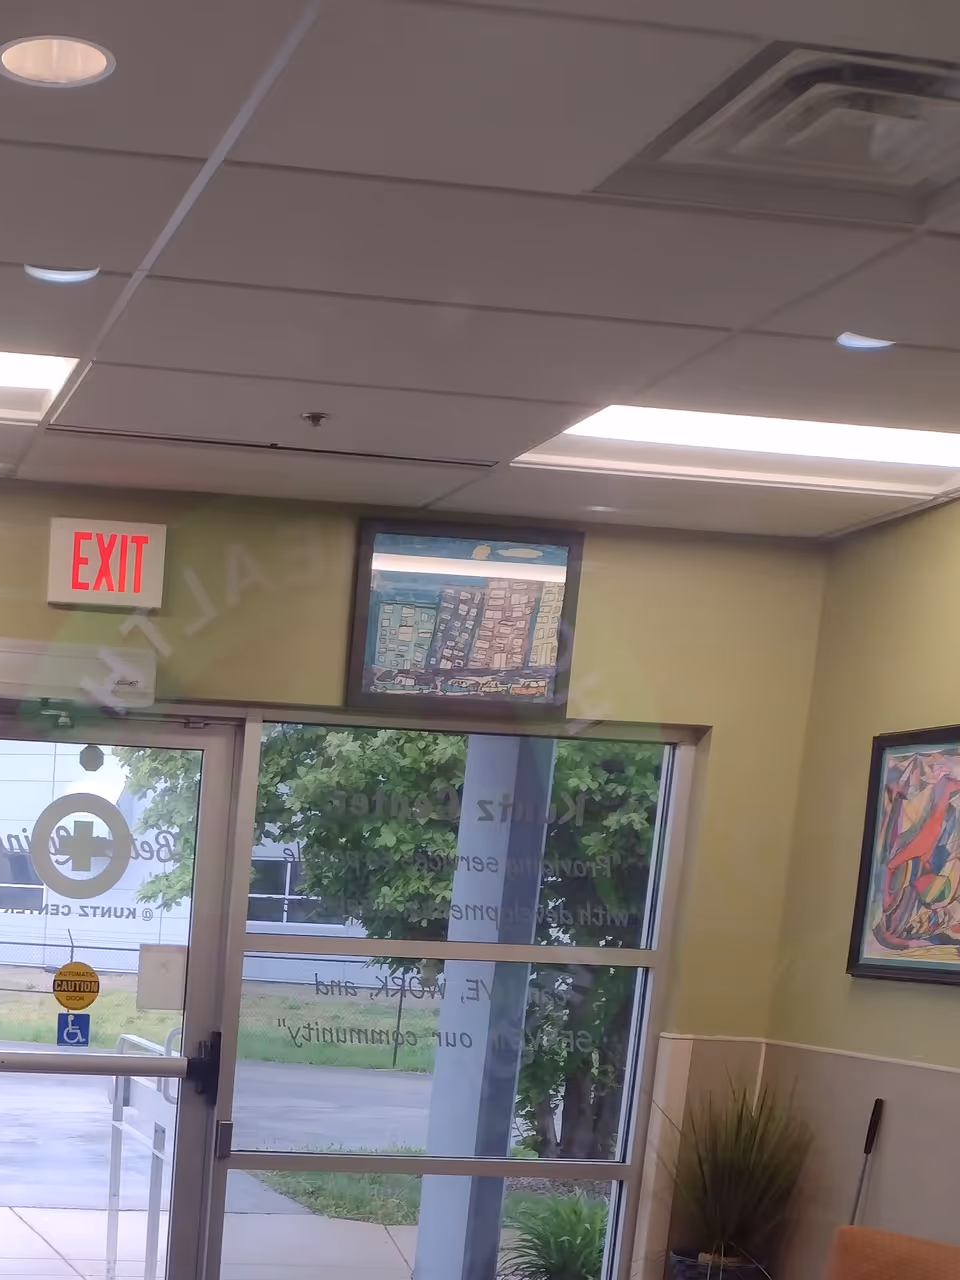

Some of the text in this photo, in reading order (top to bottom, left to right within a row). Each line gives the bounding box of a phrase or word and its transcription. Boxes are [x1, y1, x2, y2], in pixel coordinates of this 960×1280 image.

[71, 531, 149, 594] EXIT
[57, 970, 97, 979] AUTOMATIC
[54, 980, 99, 992] CAUTION
[65, 995, 86, 1003] DOOR
